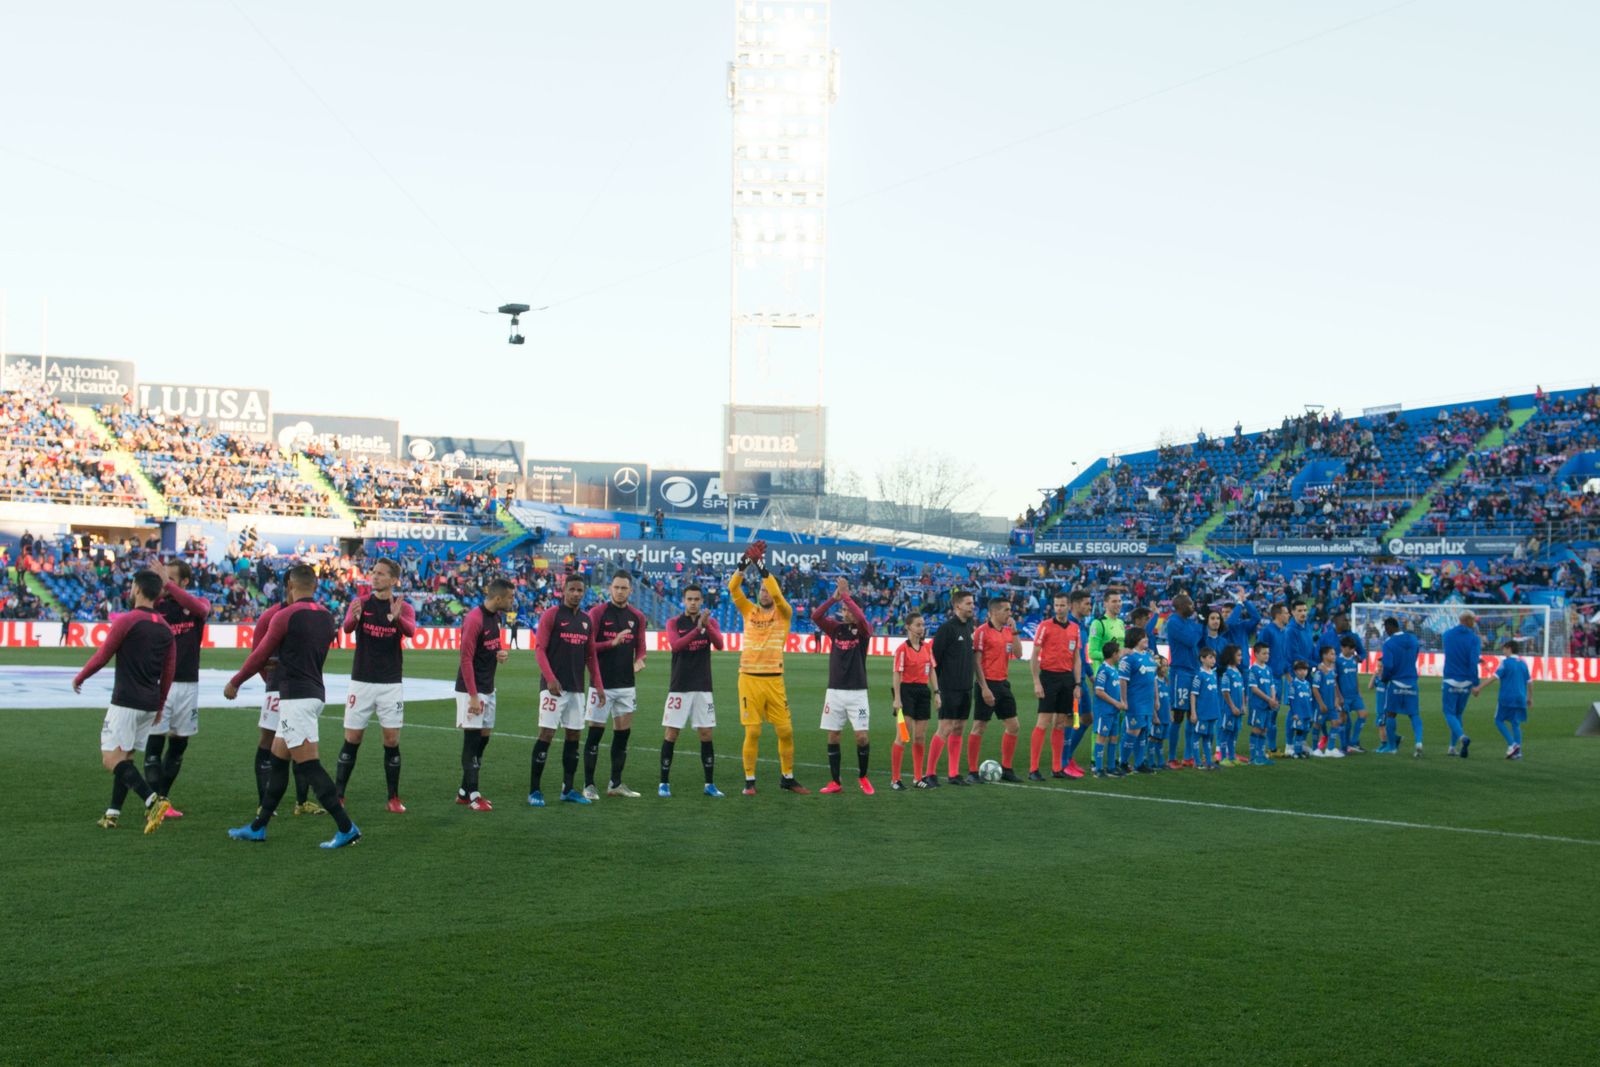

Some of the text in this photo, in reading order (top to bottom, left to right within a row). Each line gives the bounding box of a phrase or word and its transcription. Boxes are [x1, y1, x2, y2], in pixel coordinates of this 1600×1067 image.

[47, 362, 119, 381] Antonio
[61, 378, 129, 396] Ricardo
[140, 385, 267, 420] LUJISA
[702, 499, 759, 510] SPORT
[374, 526, 468, 541] HERCOTEX
[543, 542, 574, 555] Nogal
[836, 550, 869, 564] Nogal
[1044, 542, 1148, 553] REALE SEGUROS
[1276, 544, 1307, 553] estamos
[1307, 545, 1320, 553] con
[1321, 544, 1329, 553] la
[1177, 687, 1189, 699] 12
[266, 695, 280, 712] 12
[541, 696, 558, 712] 25
[667, 696, 682, 710] 23
